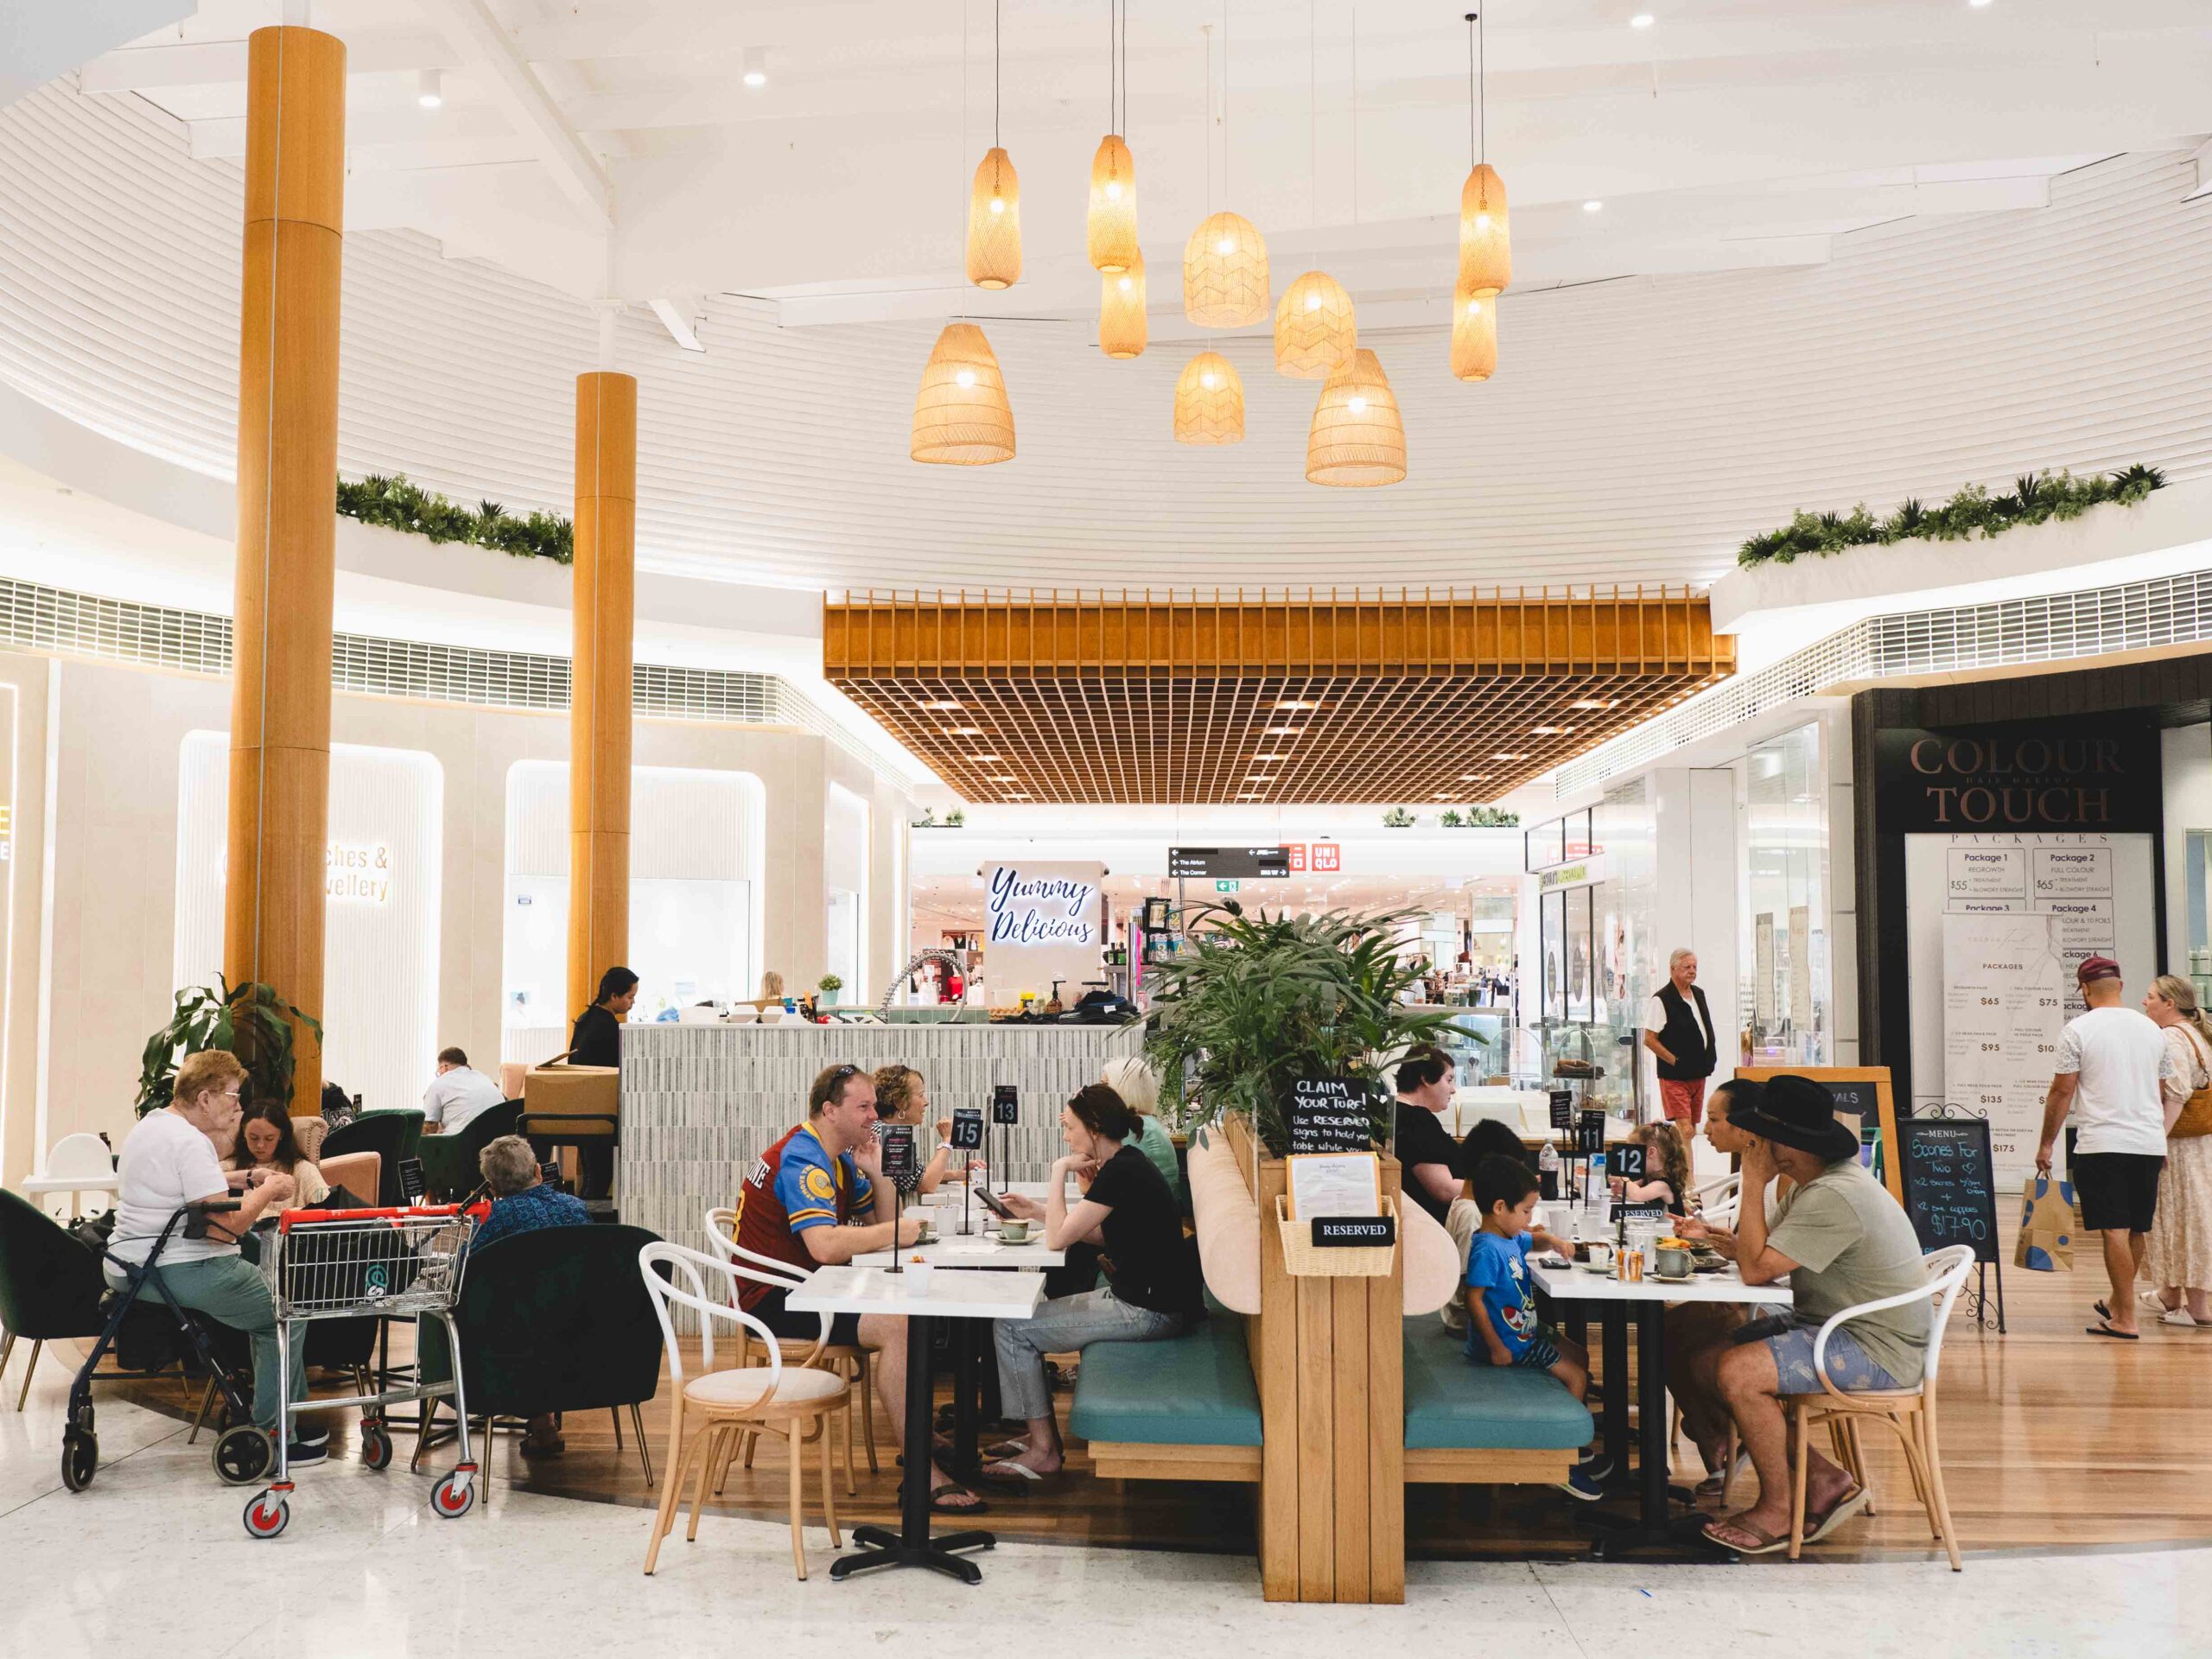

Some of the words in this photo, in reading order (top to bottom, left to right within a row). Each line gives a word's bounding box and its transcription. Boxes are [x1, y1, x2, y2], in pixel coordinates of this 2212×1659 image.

[1910, 739, 2125, 774] COLOUR
[1926, 786, 2112, 822] TOUCH
[1951, 834, 2107, 843] PACKAGES
[326, 845, 366, 868] ches
[375, 847, 387, 868] &
[1315, 847, 1335, 856] UNI
[1315, 858, 1338, 868] QLO
[1964, 853, 2001, 863] Package
[2050, 853, 2087, 863] Package
[1950, 880, 1967, 890] $55
[2037, 880, 2053, 890] $65
[991, 867, 1093, 917] Yummy
[2052, 904, 2089, 913] Package
[991, 909, 1093, 943] Delicious
[2063, 950, 2091, 959] ckage
[1980, 997, 1999, 1006] $65
[2039, 998, 2058, 1007] $75
[1981, 1043, 2000, 1052] $95
[2037, 1044, 2057, 1052] $10
[1296, 1080, 1348, 1096] CLAIM
[1294, 1096, 1329, 1109] YOUR
[1328, 1092, 1366, 1110] TURF!
[1980, 1095, 2002, 1103] $135
[997, 1103, 1014, 1121] 13
[1293, 1116, 1309, 1125] Use
[1313, 1115, 1370, 1127] RESERVED
[957, 1122, 978, 1143] 15
[1293, 1128, 1318, 1140] signs
[1335, 1129, 1355, 1139] hold
[1583, 1128, 1599, 1148] 11
[1293, 1141, 1314, 1151] table
[1319, 1142, 1343, 1152] while
[1911, 1139, 1954, 1158] Scones
[1957, 1141, 1979, 1158] For
[1993, 1144, 2015, 1153] $175
[1618, 1148, 1641, 1173] 12
[1925, 1160, 1951, 1173] Two
[1323, 1224, 1387, 1236] RESERVED
[1931, 1213, 1986, 1240] $17.90
